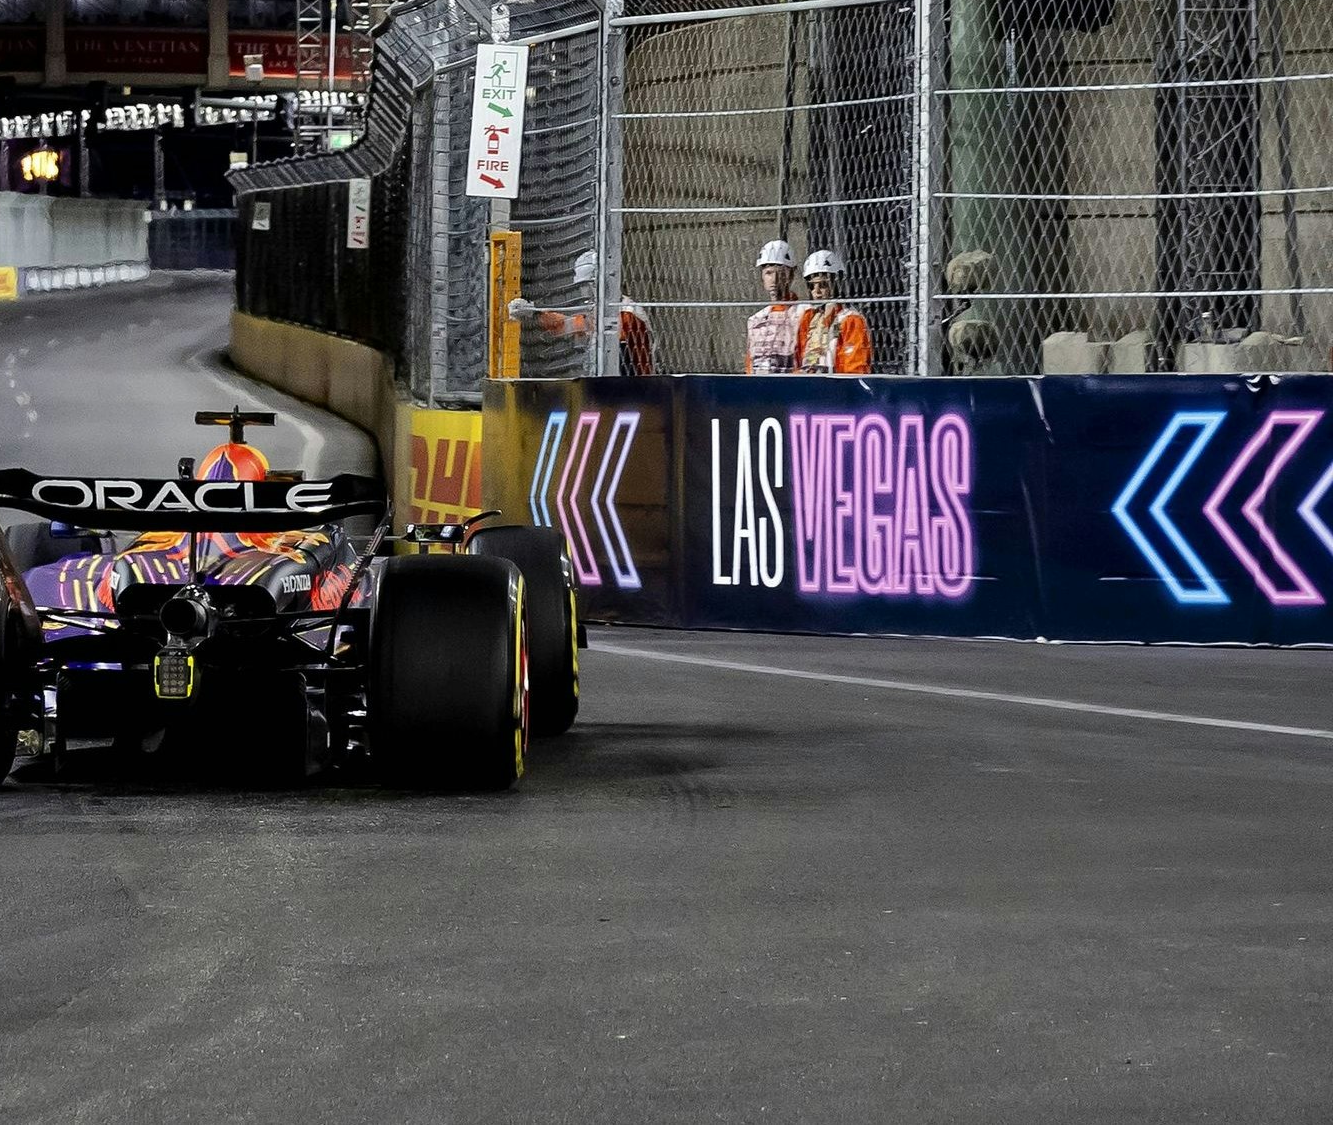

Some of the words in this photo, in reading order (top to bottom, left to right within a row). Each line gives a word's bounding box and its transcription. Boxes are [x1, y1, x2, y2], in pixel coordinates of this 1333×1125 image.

[74, 39, 102, 52] THE
[111, 39, 201, 54] VENETIAN
[234, 42, 267, 56] THE
[482, 88, 517, 100] EXIT
[476, 160, 509, 172] FIRE
[31, 479, 334, 513] ORACLE
[710, 417, 785, 589] LAS
[789, 412, 974, 599] VEGAS
